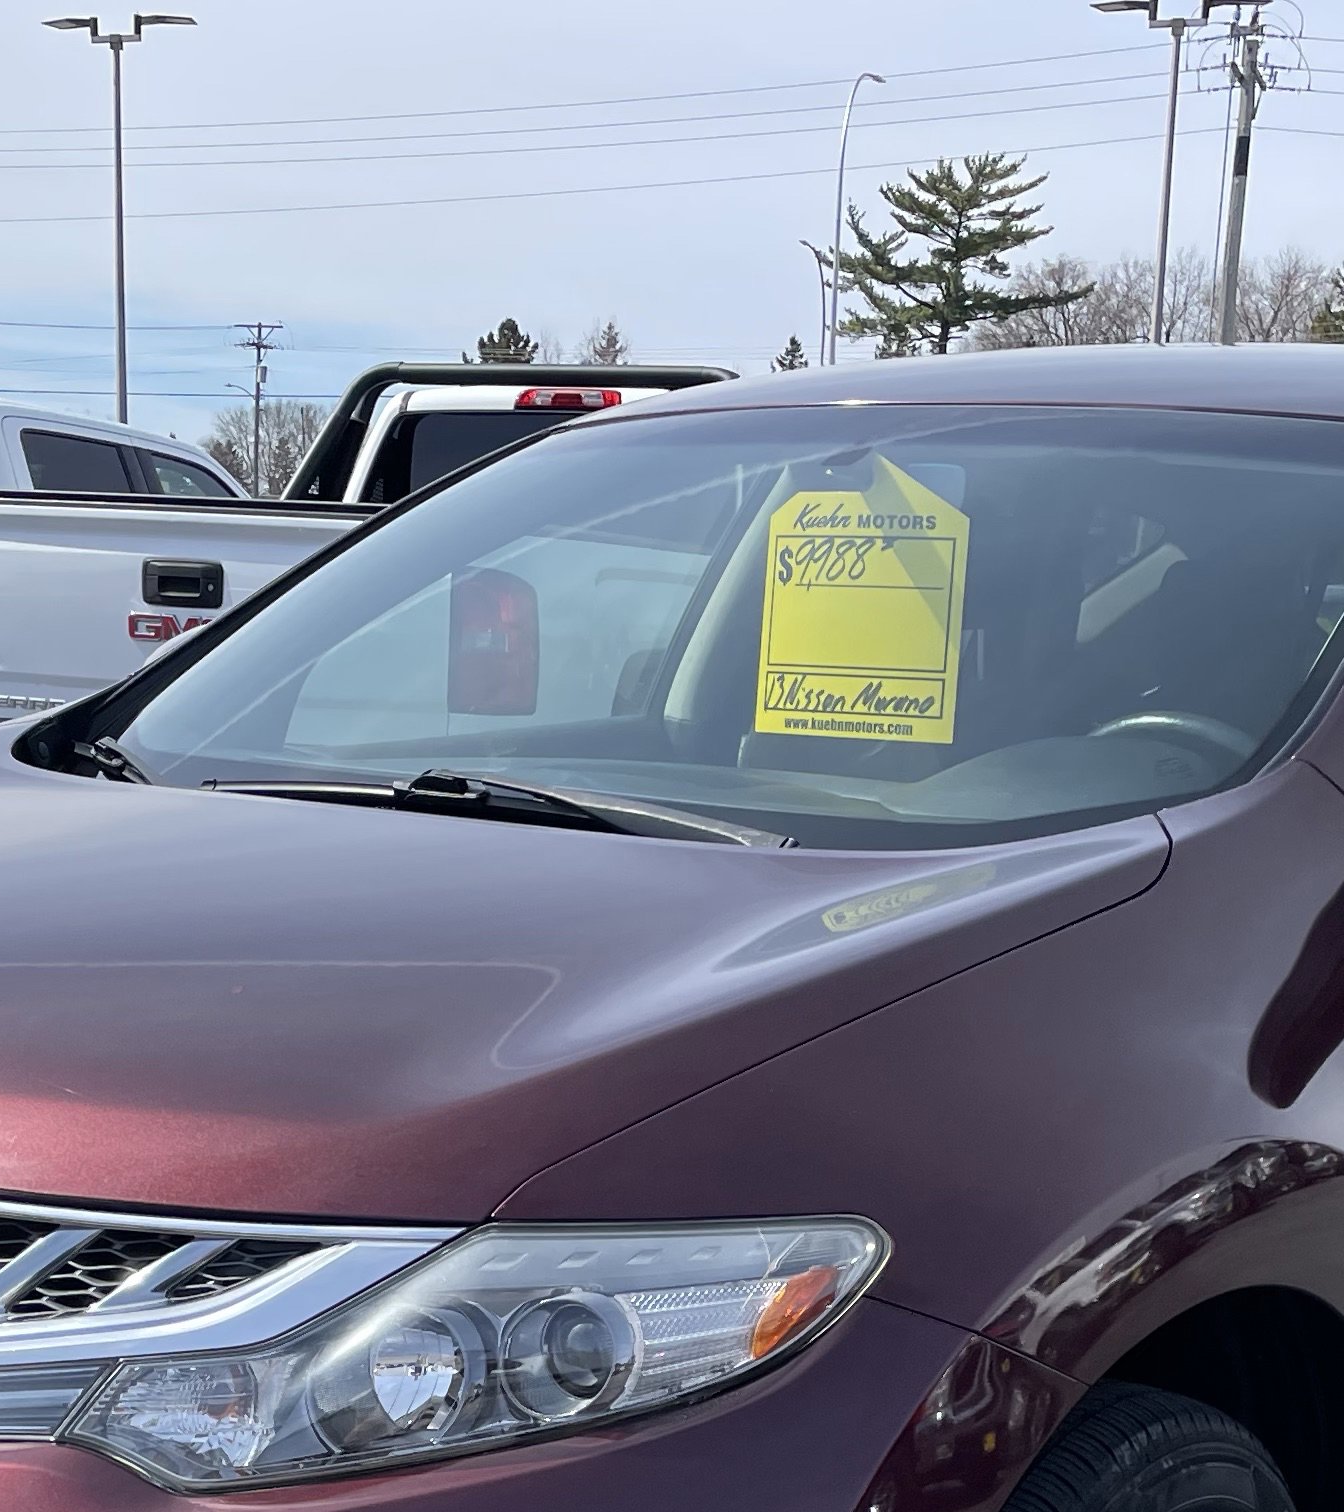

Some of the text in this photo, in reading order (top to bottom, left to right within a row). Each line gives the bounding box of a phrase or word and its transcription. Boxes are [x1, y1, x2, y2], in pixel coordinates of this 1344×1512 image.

[793, 503, 937, 532] Kuehn MOTORS
[128, 611, 216, 641] GM
[850, 681, 935, 714] Murano
[784, 717, 913, 736] www.kuehnmotors.com
